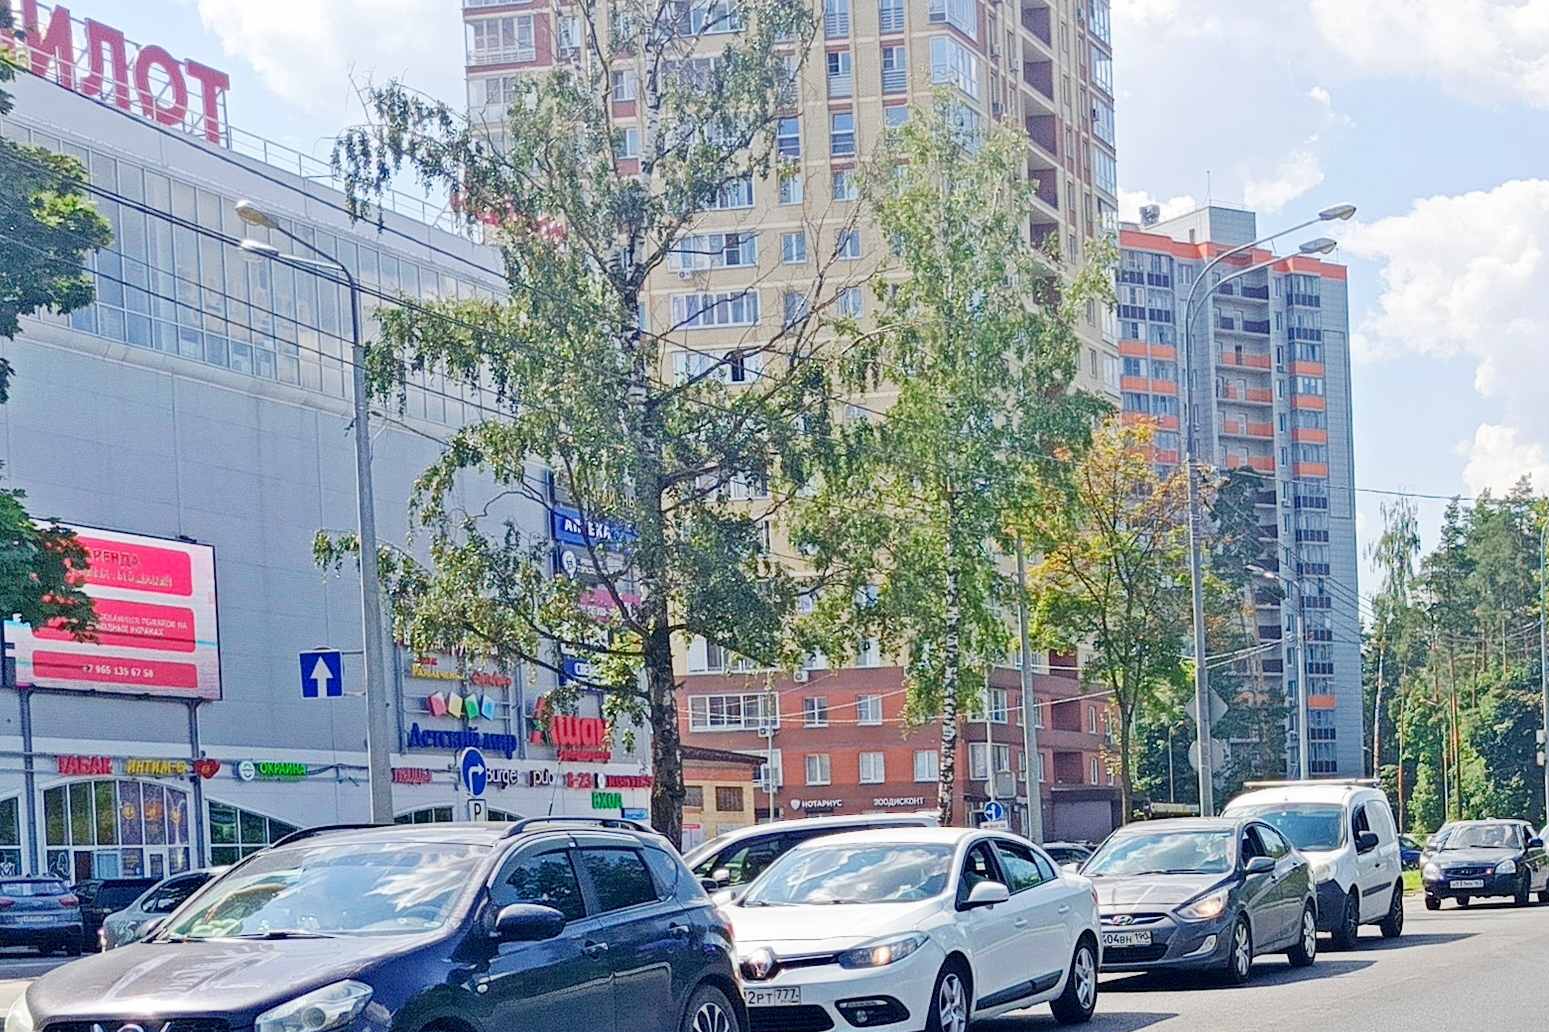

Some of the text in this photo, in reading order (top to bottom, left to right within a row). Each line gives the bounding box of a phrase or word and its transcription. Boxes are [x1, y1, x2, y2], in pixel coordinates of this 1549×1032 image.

[0, 0, 230, 145] ИЛОТ
[56, 756, 113, 776] ТАБАК
[802, 799, 842, 808] НОТАРИУС
[873, 796, 924, 808] ЗООДИСКОНТ
[744, 988, 796, 1005] 2РТ 777
